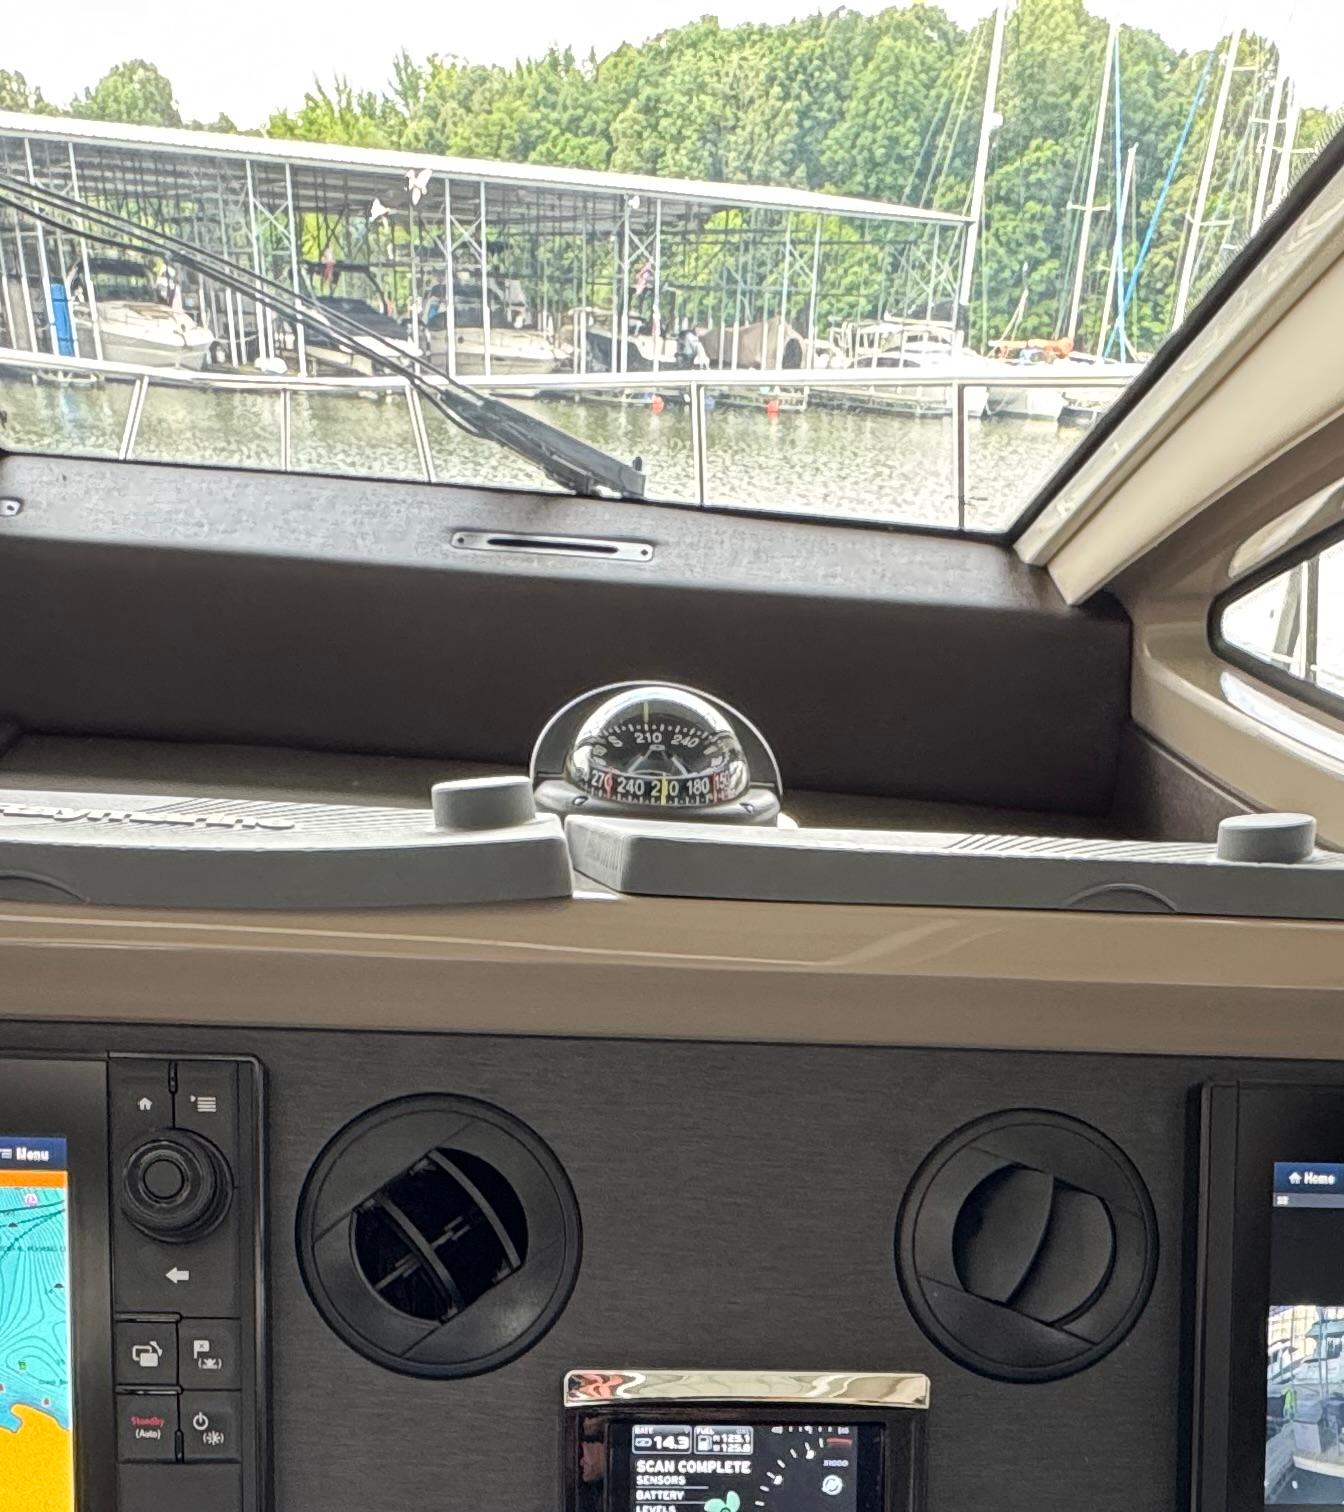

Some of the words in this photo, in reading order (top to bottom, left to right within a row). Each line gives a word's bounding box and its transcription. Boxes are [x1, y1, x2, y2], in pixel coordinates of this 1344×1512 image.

[634, 732, 663, 744] 210
[670, 735, 699, 749] 240
[616, 777, 645, 796] 240
[650, 780, 680, 797] 20
[686, 777, 710, 796] 180
[16, 1147, 50, 1163] Menu
[1304, 1172, 1336, 1186] Home
[654, 1435, 690, 1450] 14.3
[636, 1459, 675, 1473] SCAN
[678, 1460, 752, 1474] COMPLETE
[636, 1475, 687, 1486] SENSORS
[635, 1490, 685, 1501] BATTERY
